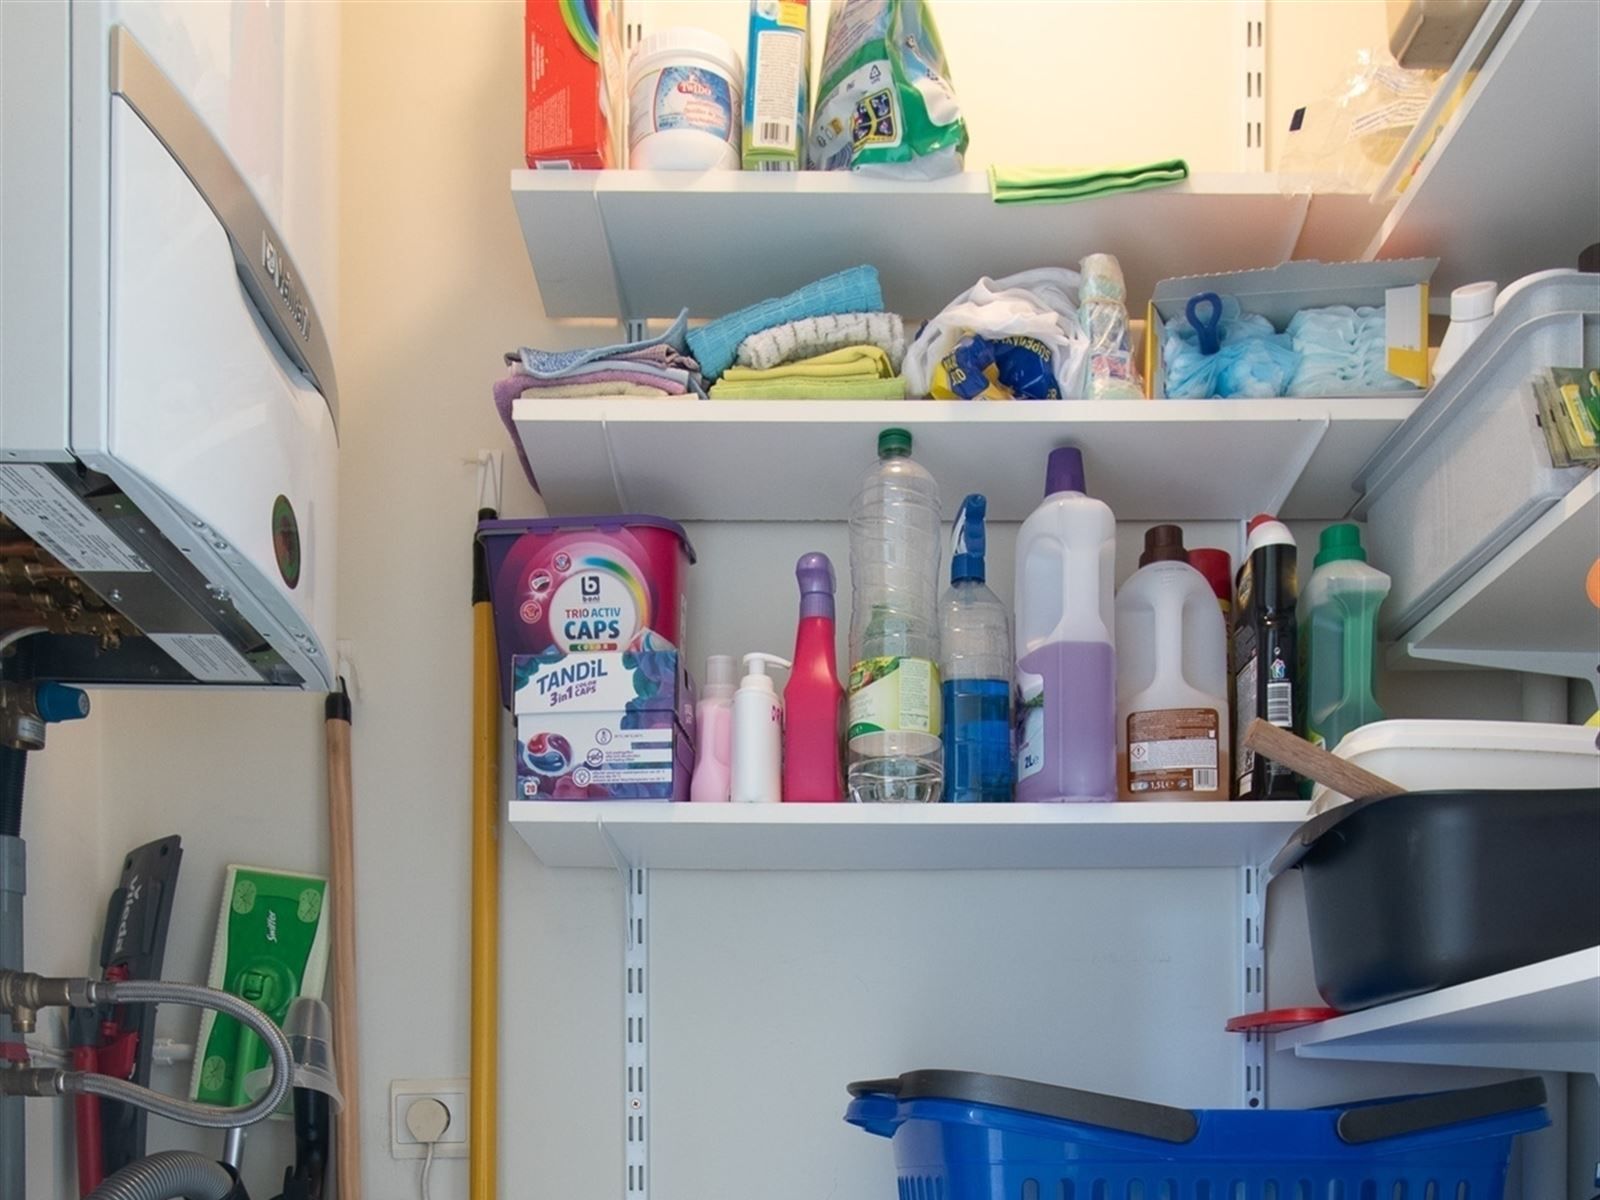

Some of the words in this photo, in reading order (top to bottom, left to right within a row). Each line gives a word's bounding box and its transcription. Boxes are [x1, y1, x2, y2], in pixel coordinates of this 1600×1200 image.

[565, 608, 590, 619] TRIO
[591, 607, 621, 618] ACTIV
[564, 620, 620, 640] CAPS
[550, 686, 573, 707] 3in1
[574, 686, 596, 697] CAPS
